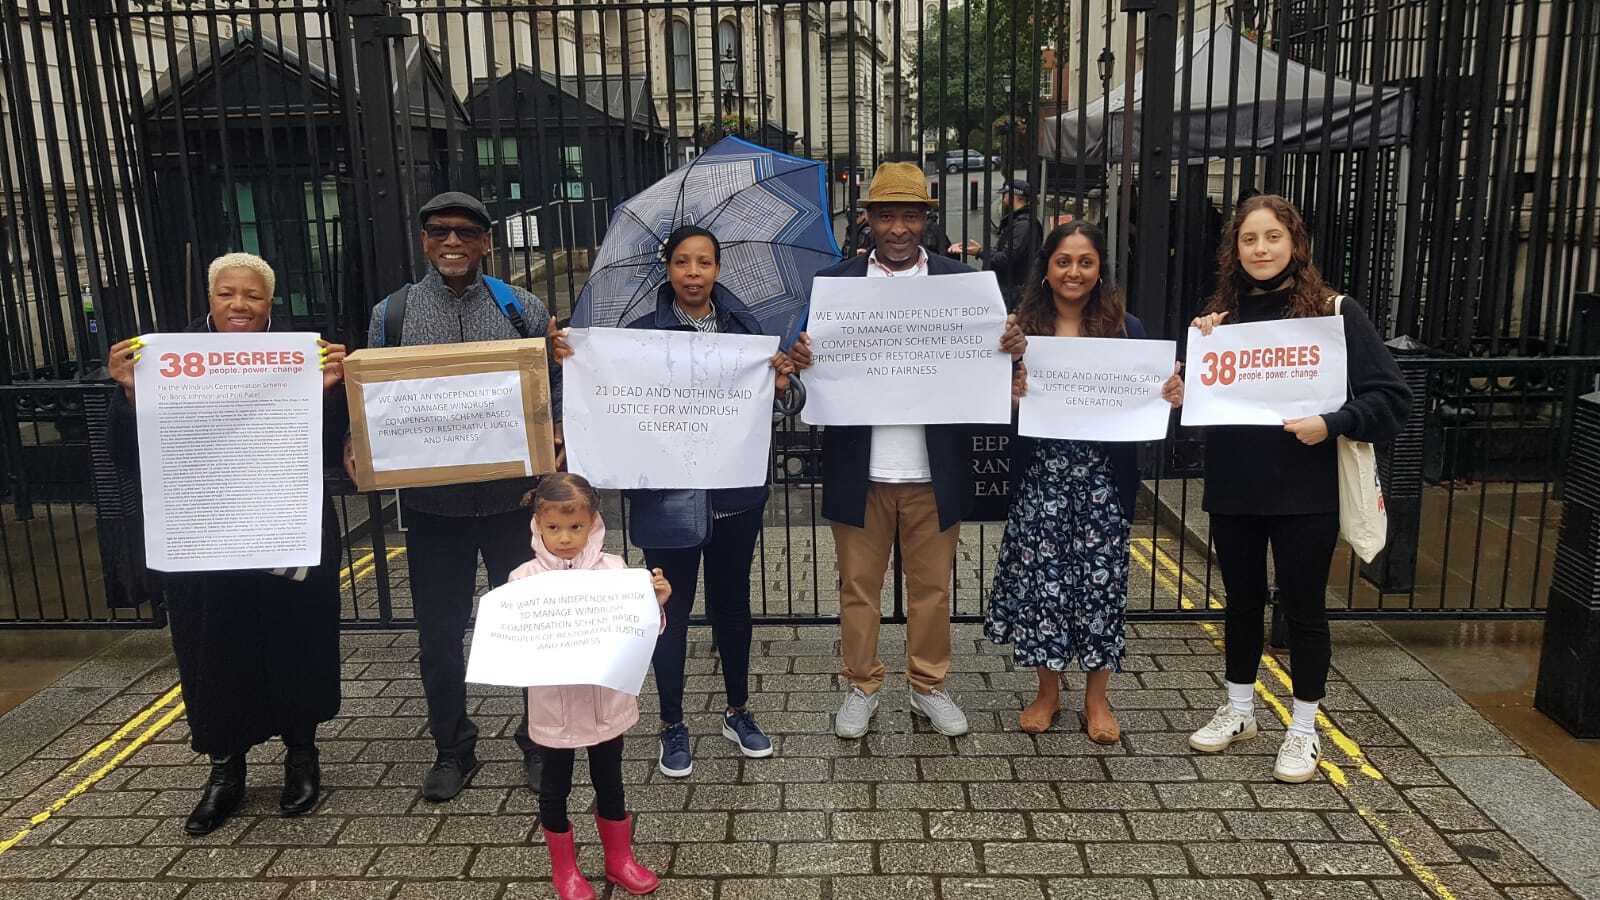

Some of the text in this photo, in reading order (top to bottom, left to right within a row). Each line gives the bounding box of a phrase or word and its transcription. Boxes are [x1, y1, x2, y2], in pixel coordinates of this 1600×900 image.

[816, 306, 990, 321] WE WANT AN INDEPENDENT BODY
[841, 323, 963, 335] TO MANAGE WINDRUSH
[821, 336, 982, 349] COMPENSATION SCHEME BASED
[813, 350, 992, 363] PRINCIPLES OF RESTORATIVE JUSTICE
[160, 352, 305, 378] 38 DEGREES
[867, 366, 937, 376] AND FAIRNESS
[1201, 345, 1320, 386] 38 DEGREES
[1046, 371, 1069, 379] DEAD
[1072, 372, 1092, 380] AND
[1095, 373, 1137, 383] NOTHING
[1140, 375, 1160, 383] SAID
[1239, 369, 1320, 381] people. power. change.
[379, 396, 392, 404] WE
[395, 394, 417, 402] WANT
[434, 390, 491, 400] INDEPENDENT
[493, 388, 513, 396] BODY
[595, 386, 752, 400] 21 DEAD AND NOTHING SAID
[1041, 384, 1077, 392] JUSTICE
[1098, 386, 1149, 396] WINDRUSH
[413, 404, 448, 412] MANAGE
[450, 402, 494, 411] WINDRUSH
[1066, 398, 1123, 407] GENERATION
[607, 404, 739, 416] JUSTICE FOR WINDRUSH
[386, 415, 448, 426] COMPENSATION
[451, 414, 484, 422] SCHEME
[379, 421, 519, 437] PRINCIPLES OF RESTORATIVE JUSTICE
[638, 422, 708, 432] GENERATION
[424, 434, 479, 444] AND FAIRNESS
[972, 436, 1010, 451] EEP
[517, 598, 540, 609] WANT
[559, 594, 620, 604] INDEPENDENT
[534, 608, 571, 618] MANAGE
[616, 627, 645, 637] JUSTICE
